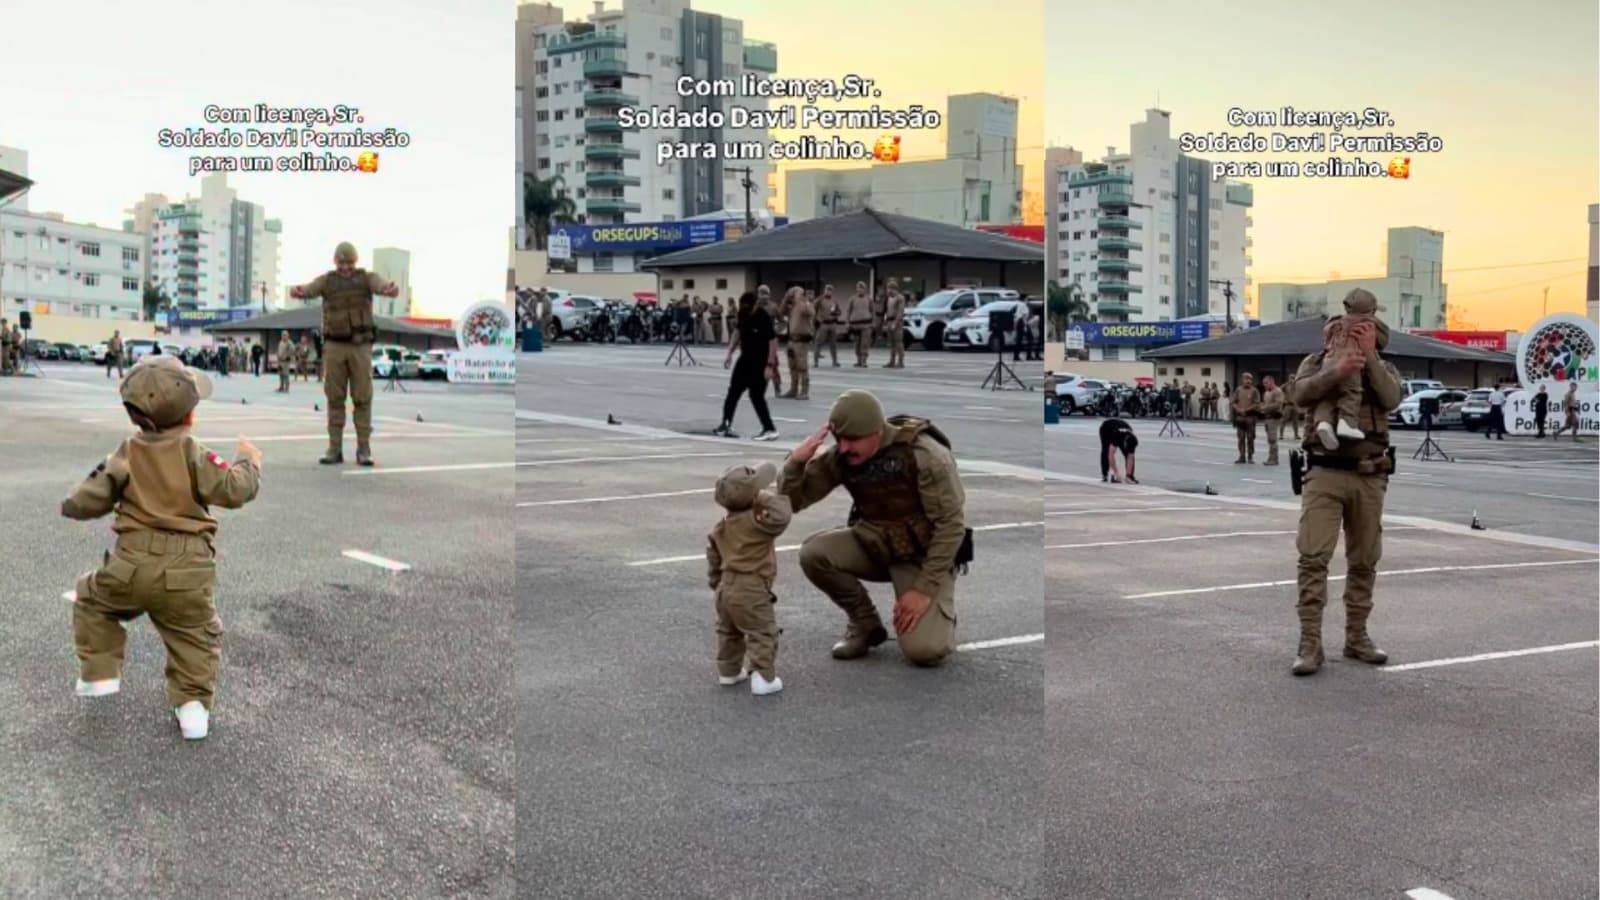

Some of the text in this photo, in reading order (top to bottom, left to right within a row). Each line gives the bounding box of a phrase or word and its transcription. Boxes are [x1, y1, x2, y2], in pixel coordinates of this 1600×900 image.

[592, 227, 659, 242] ORSEGUPS
[1102, 325, 1156, 337] ORSEGUPS
[1515, 417, 1560, 430] Polcia
